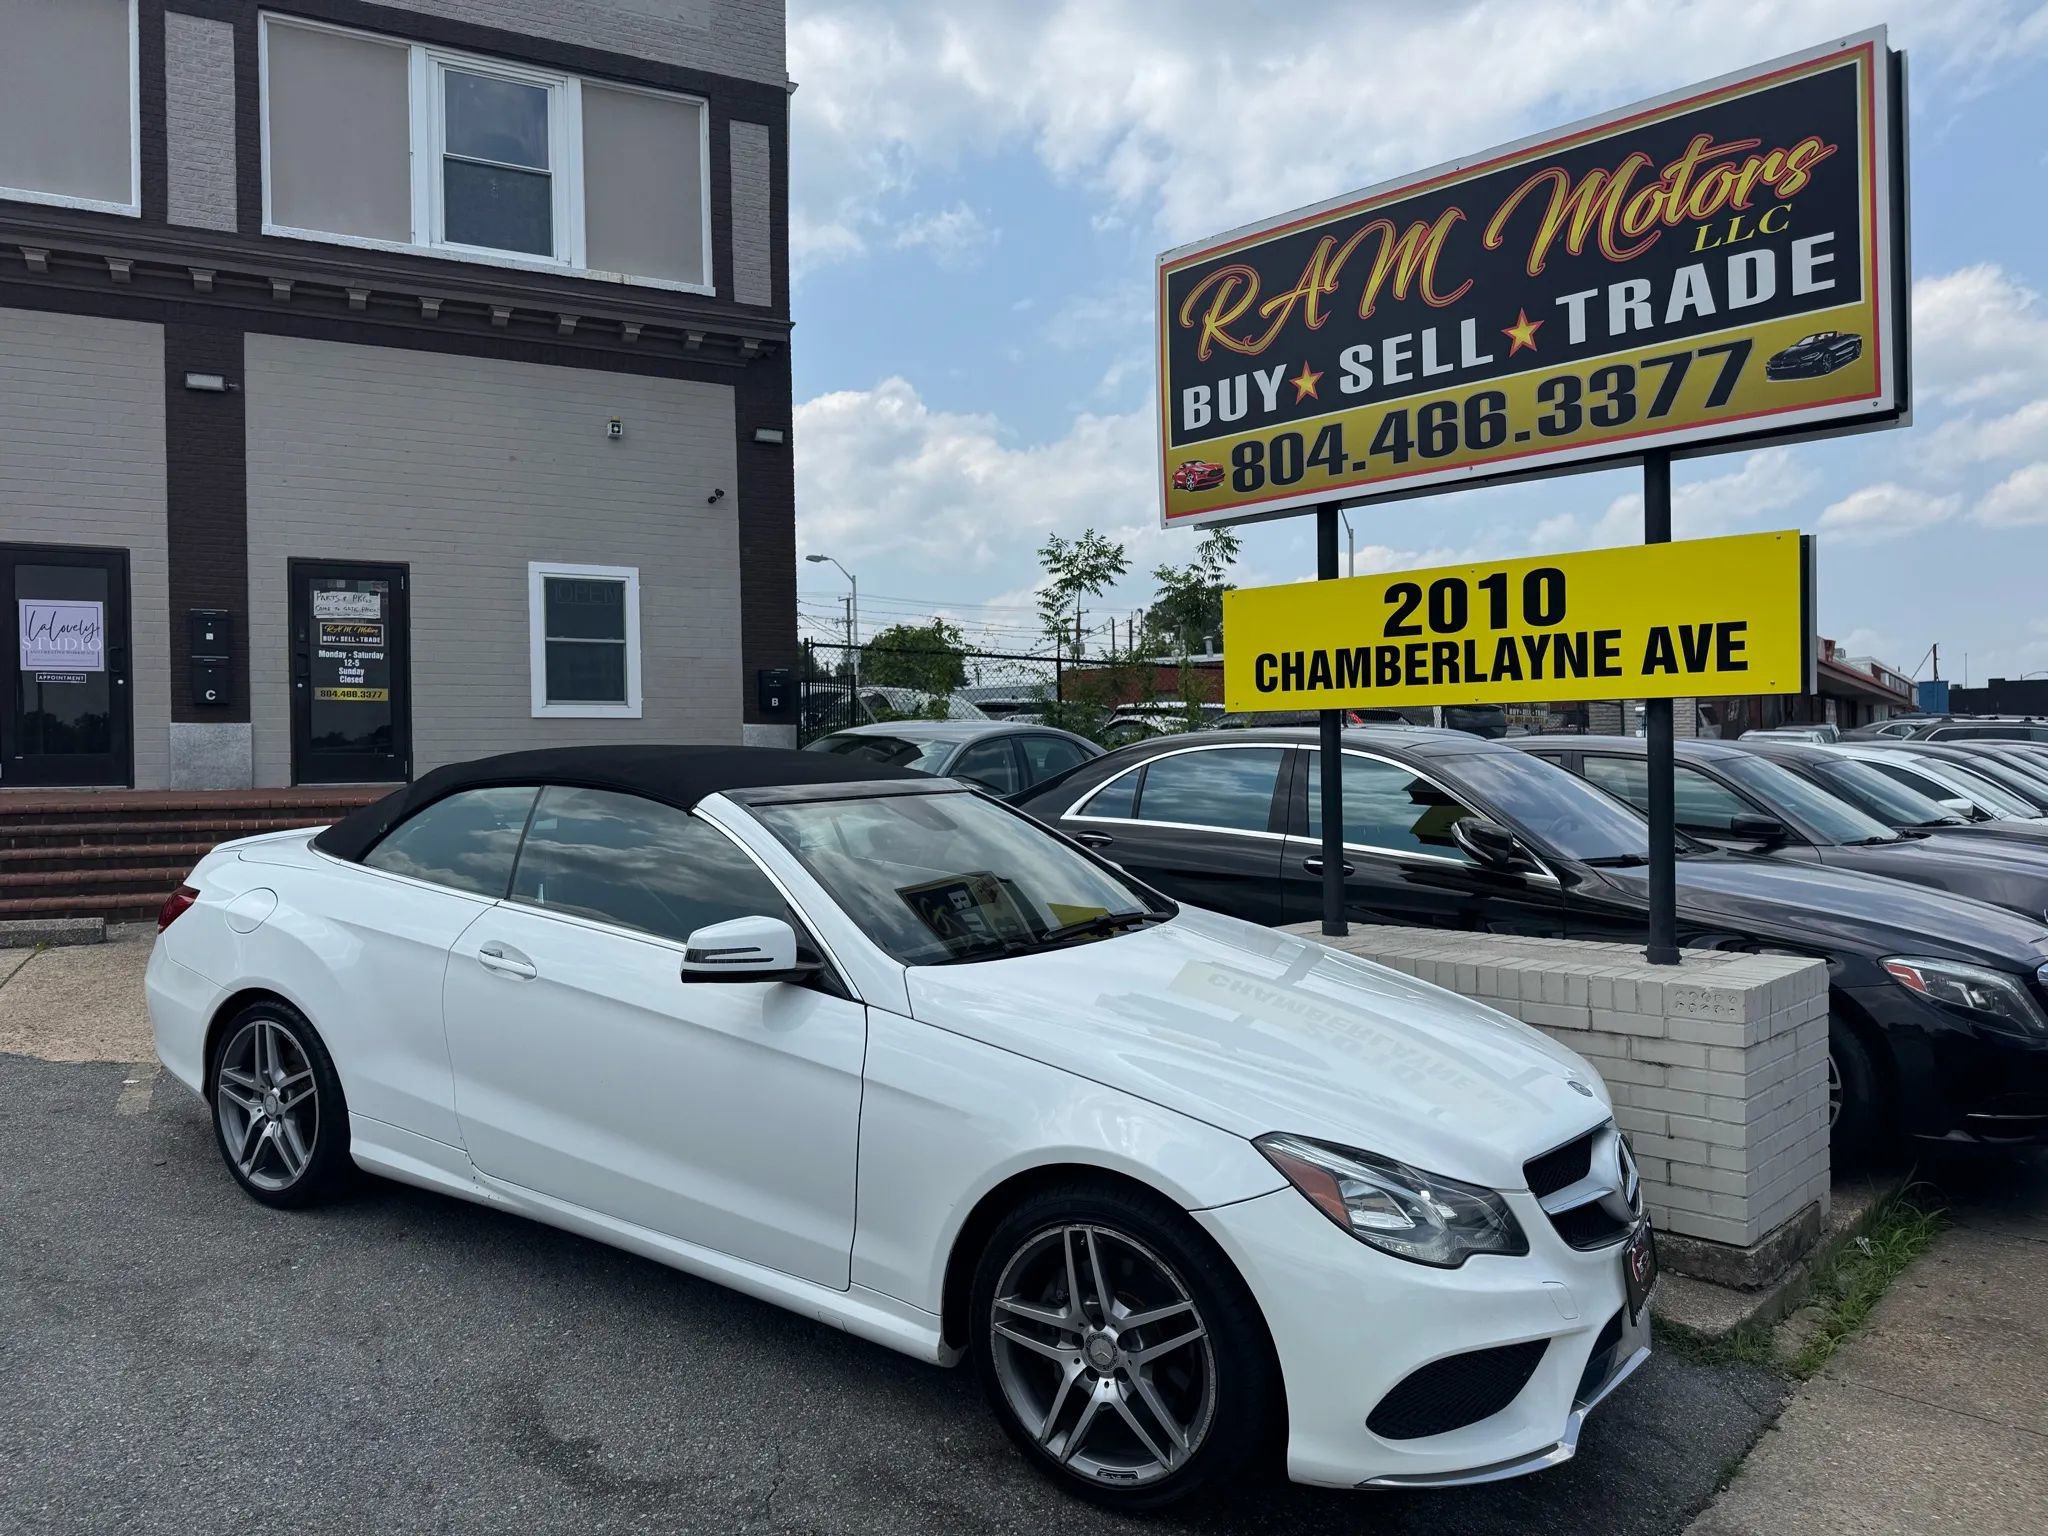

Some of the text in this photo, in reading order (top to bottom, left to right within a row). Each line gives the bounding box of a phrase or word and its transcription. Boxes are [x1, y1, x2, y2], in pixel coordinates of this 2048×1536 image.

[1689, 203, 1793, 254] LLC
[1179, 133, 1838, 362] RAM Motors
[1182, 231, 1836, 431] BUY SELL TRADE
[1231, 337, 1755, 494] 804.466.3377
[1383, 567, 1567, 638] 2010
[22, 637, 102, 651] STUDIO
[340, 635, 356, 643] SELL
[318, 649, 347, 659] Monday
[353, 650, 384, 660] Saturday
[1254, 621, 1749, 694] CHAMBERLAYNE AVE
[343, 659, 360, 667] 12-5
[338, 667, 365, 676] Sunday
[339, 675, 364, 684] Closed
[205, 689, 216, 701] C
[771, 697, 779, 707] B
